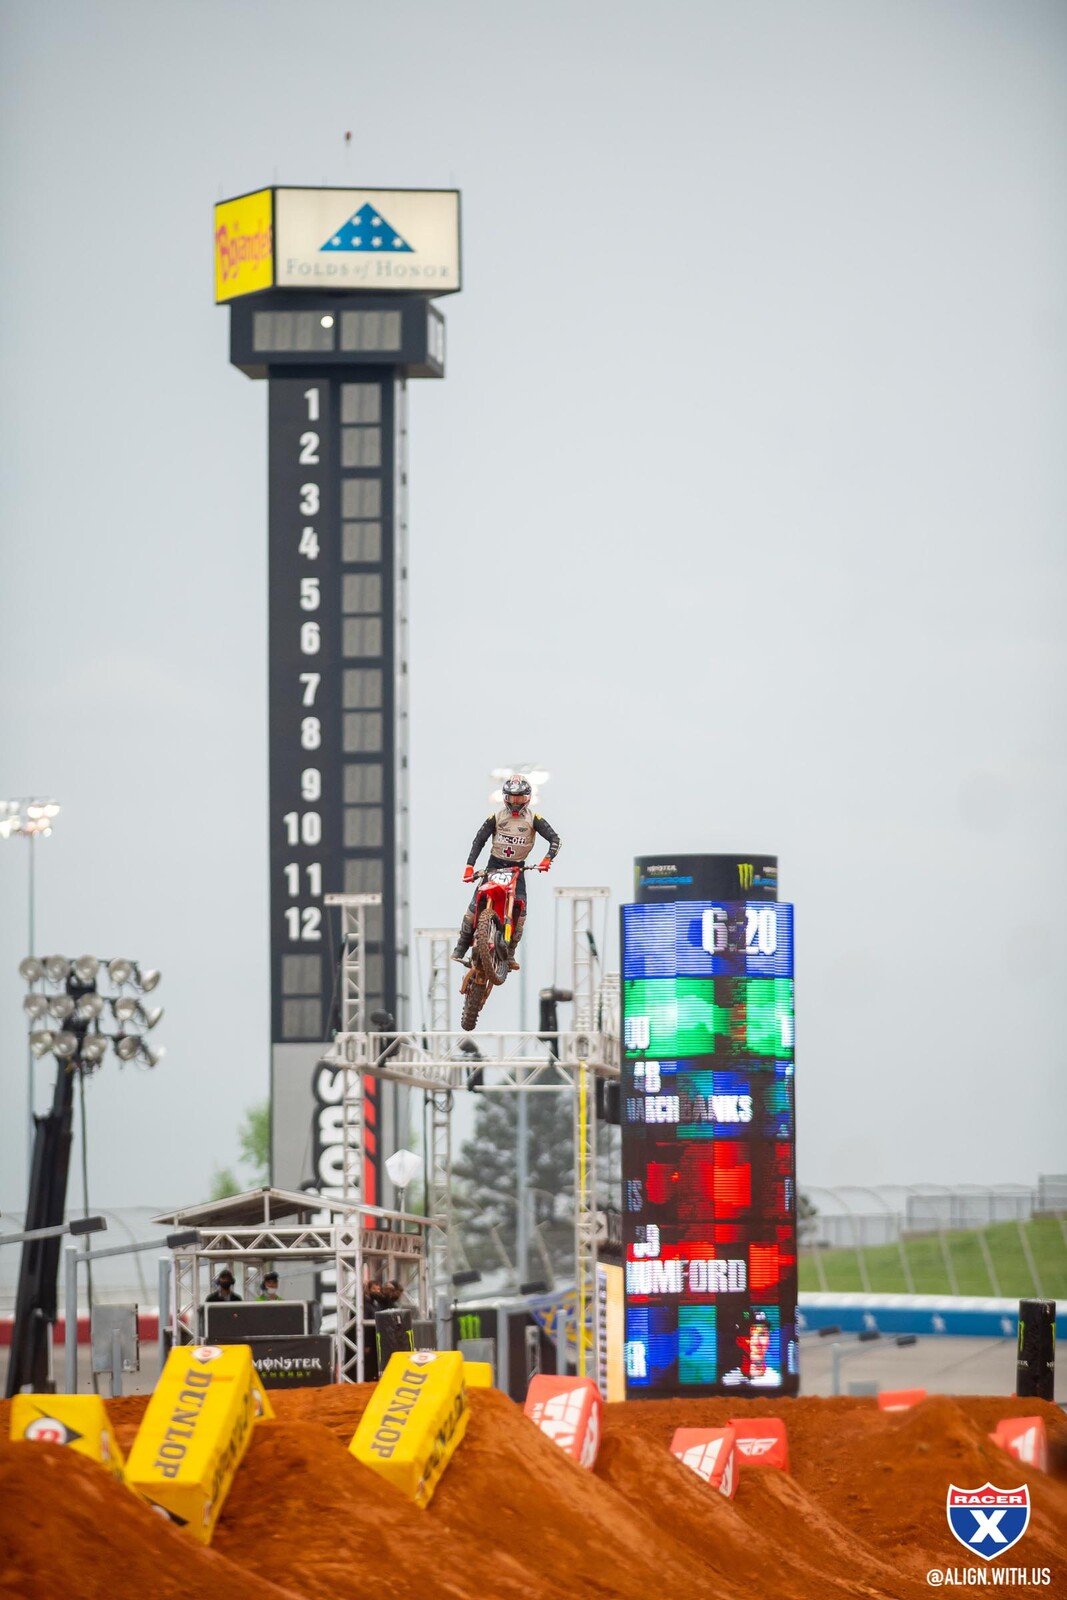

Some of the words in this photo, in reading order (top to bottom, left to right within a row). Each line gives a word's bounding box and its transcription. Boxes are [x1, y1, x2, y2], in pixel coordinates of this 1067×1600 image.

[286, 258, 349, 276] FOLDS
[352, 259, 370, 279] of
[375, 260, 450, 278] HONOR
[303, 387, 320, 421] 1
[299, 431, 320, 465] 2
[299, 483, 321, 516] 3
[298, 526, 320, 560] 4
[299, 577, 321, 611] 5
[300, 621, 321, 655] 6
[299, 672, 321, 707] 7
[300, 716, 322, 750] 8
[301, 767, 322, 801] 9
[283, 811, 322, 846] 10
[284, 862, 322, 897] 11
[284, 906, 322, 941] 12
[251, 1356, 322, 1372] MONSTER
[260, 1370, 312, 1378] ENERGY
[154, 1368, 213, 1479] DUNLOP
[370, 1368, 428, 1459] DUNLOP
